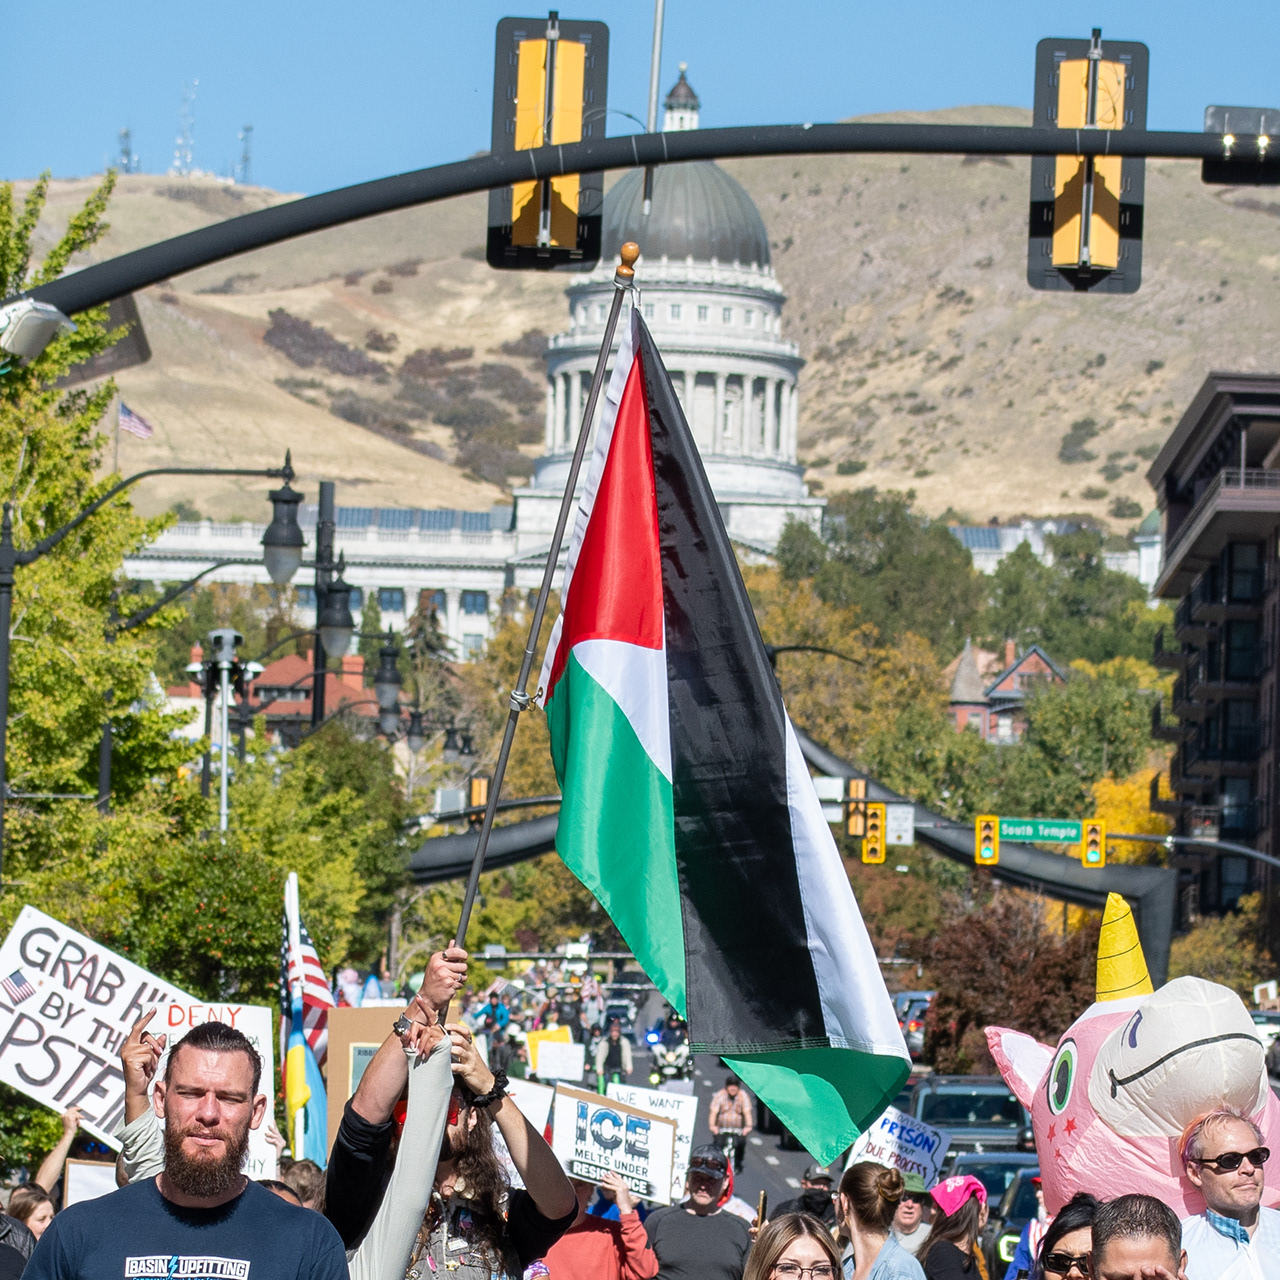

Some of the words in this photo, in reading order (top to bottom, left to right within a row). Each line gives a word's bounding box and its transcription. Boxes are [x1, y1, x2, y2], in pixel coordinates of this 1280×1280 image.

[1001, 823, 1034, 836] South
[1038, 824, 1078, 840] Temple
[19, 926, 127, 1007] GRAB
[39, 991, 85, 1028] BY
[167, 1003, 242, 1030] DENY
[616, 1091, 637, 1106] WE
[648, 1095, 684, 1110] WANT
[574, 1100, 651, 1163] ICE
[880, 1117, 936, 1154] PRISON
[574, 1148, 610, 1166] MELTS
[614, 1159, 648, 1177] UNDER
[865, 1141, 887, 1160] DUE
[887, 1151, 928, 1180] PROCESS
[572, 1161, 648, 1194] RESISNCE
[129, 1259, 168, 1274] BASIN
[178, 1259, 246, 1277] UPFITTING
